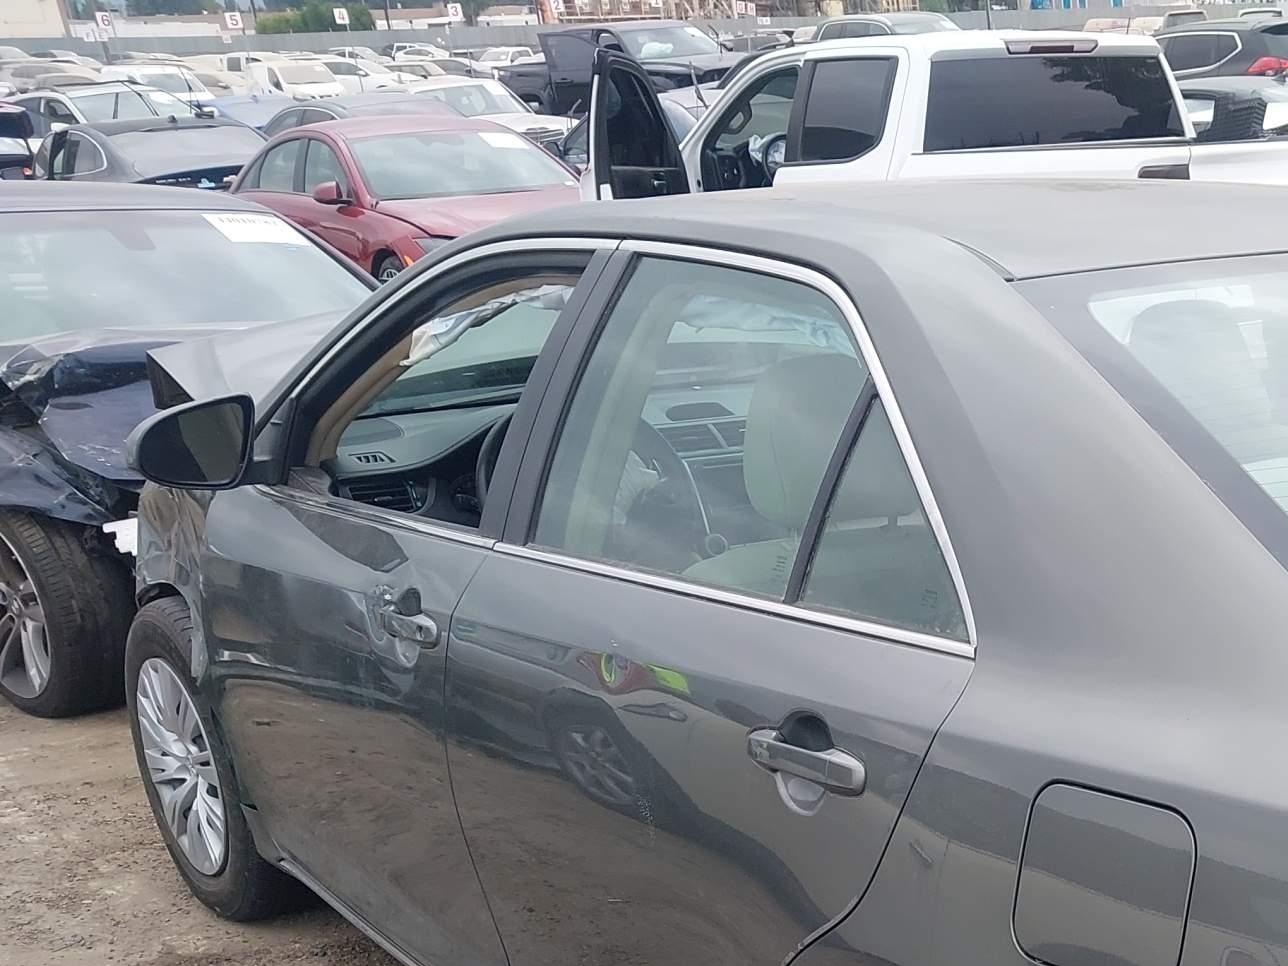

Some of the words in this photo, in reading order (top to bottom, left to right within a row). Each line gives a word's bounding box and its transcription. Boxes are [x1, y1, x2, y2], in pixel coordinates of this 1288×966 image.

[337, 10, 346, 22] 4
[449, 6, 459, 17] 3
[101, 14, 111, 27] 6
[230, 14, 240, 26] 5
